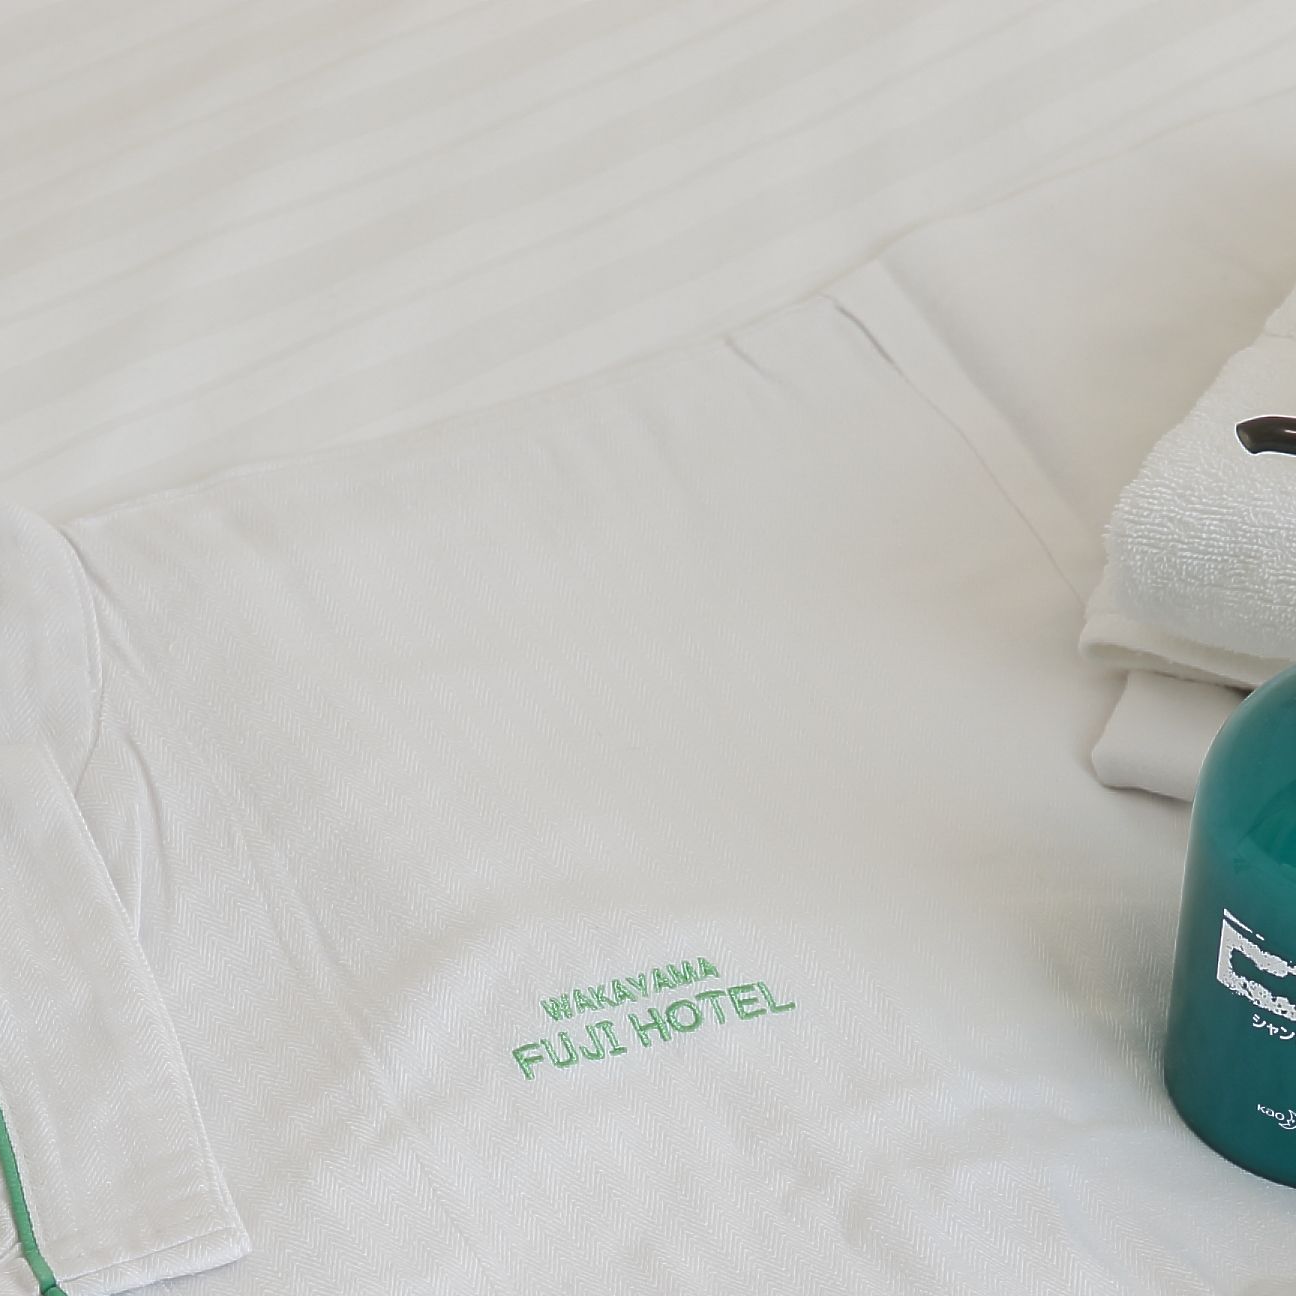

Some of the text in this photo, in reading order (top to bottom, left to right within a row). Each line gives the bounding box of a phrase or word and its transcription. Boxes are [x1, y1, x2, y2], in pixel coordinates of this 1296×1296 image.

[540, 957, 721, 1022] WAKAYAMA
[512, 981, 796, 1081] FUJI HOTEL
